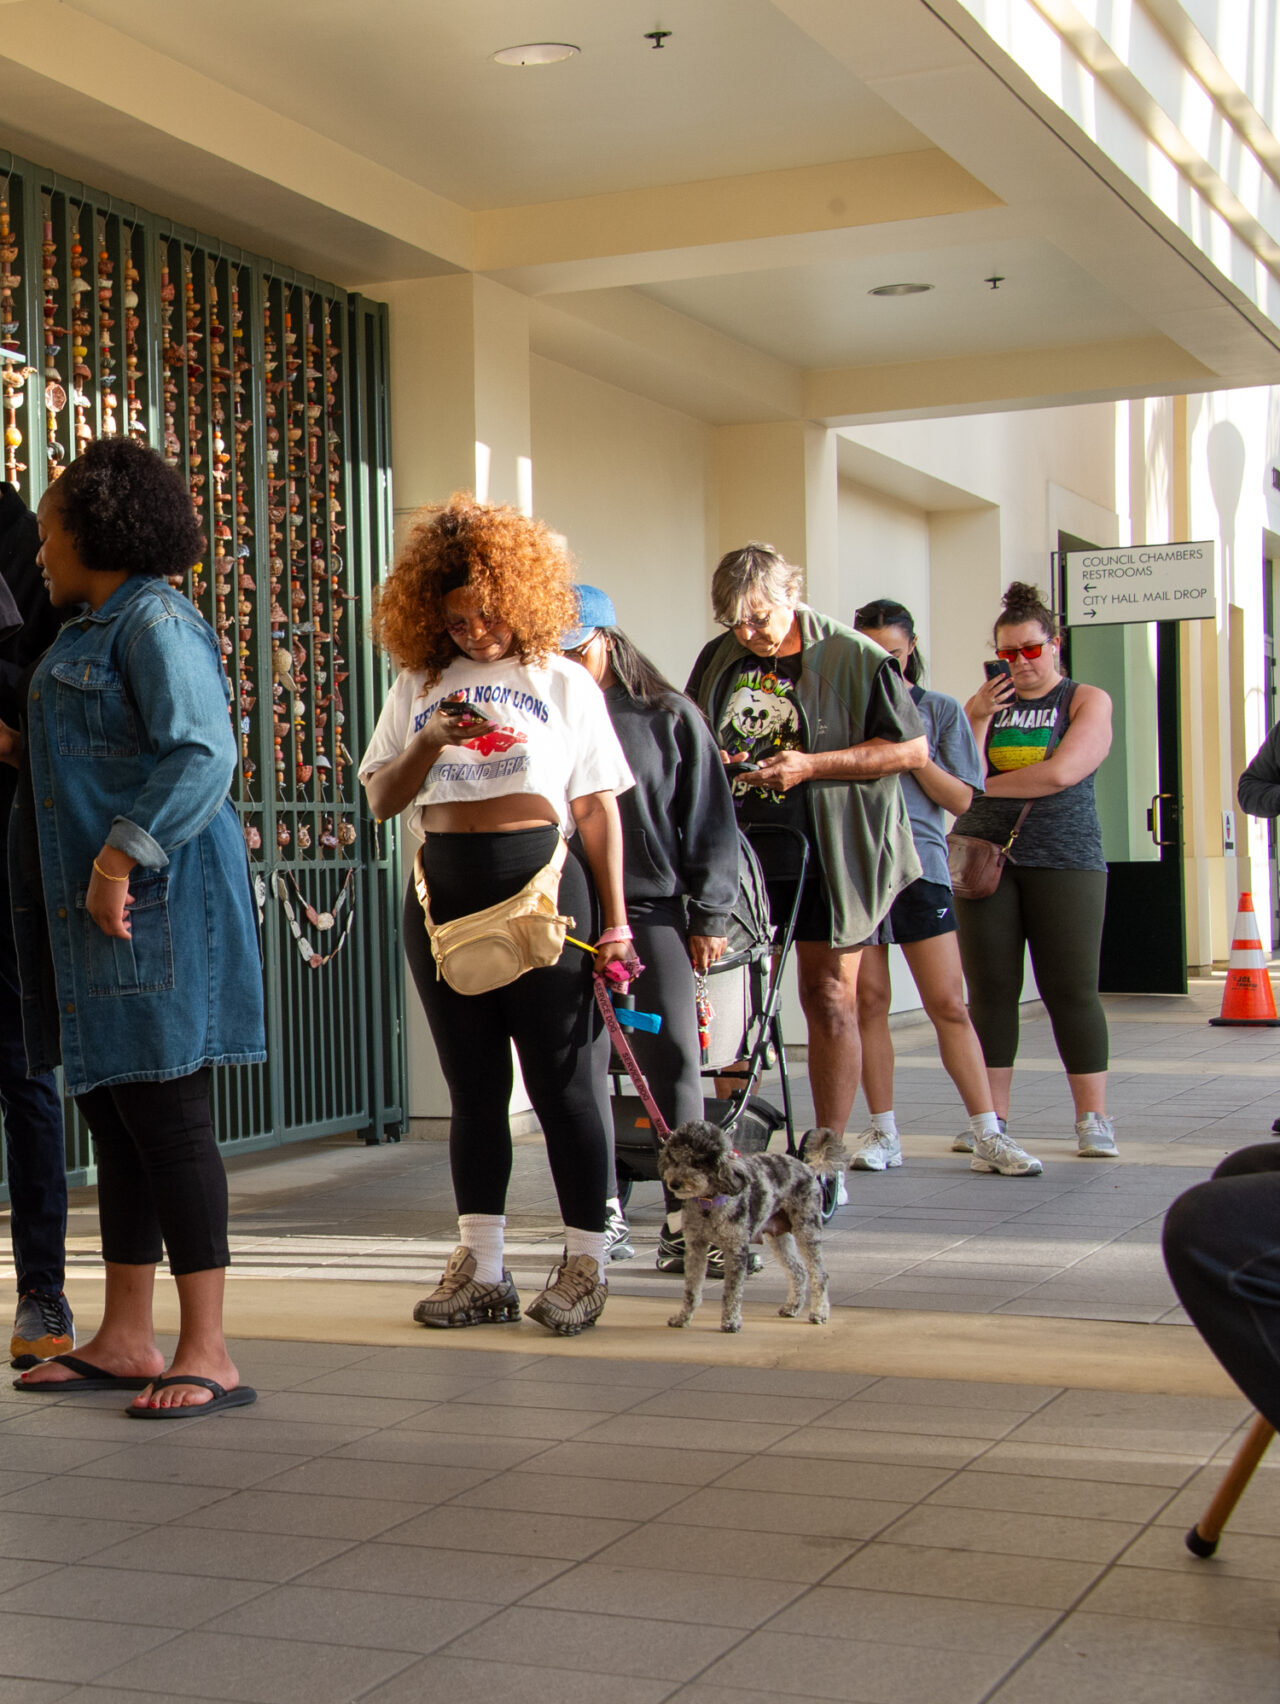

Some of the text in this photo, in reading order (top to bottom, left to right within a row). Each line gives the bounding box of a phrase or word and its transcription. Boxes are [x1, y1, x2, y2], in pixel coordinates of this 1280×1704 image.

[1082, 549, 1203, 567] COUNCIL CHAMBERS
[1082, 566, 1152, 580] RESTROOMS
[1082, 588, 1208, 606] CITY HALL MAIL DROP
[474, 685, 550, 723] NOON LIONS
[994, 707, 1060, 729] JAMAICA
[439, 763, 491, 781] GRAND
[594, 982, 618, 1033] SERVICE DOG
[622, 1052, 650, 1101] SERVICE DOG
